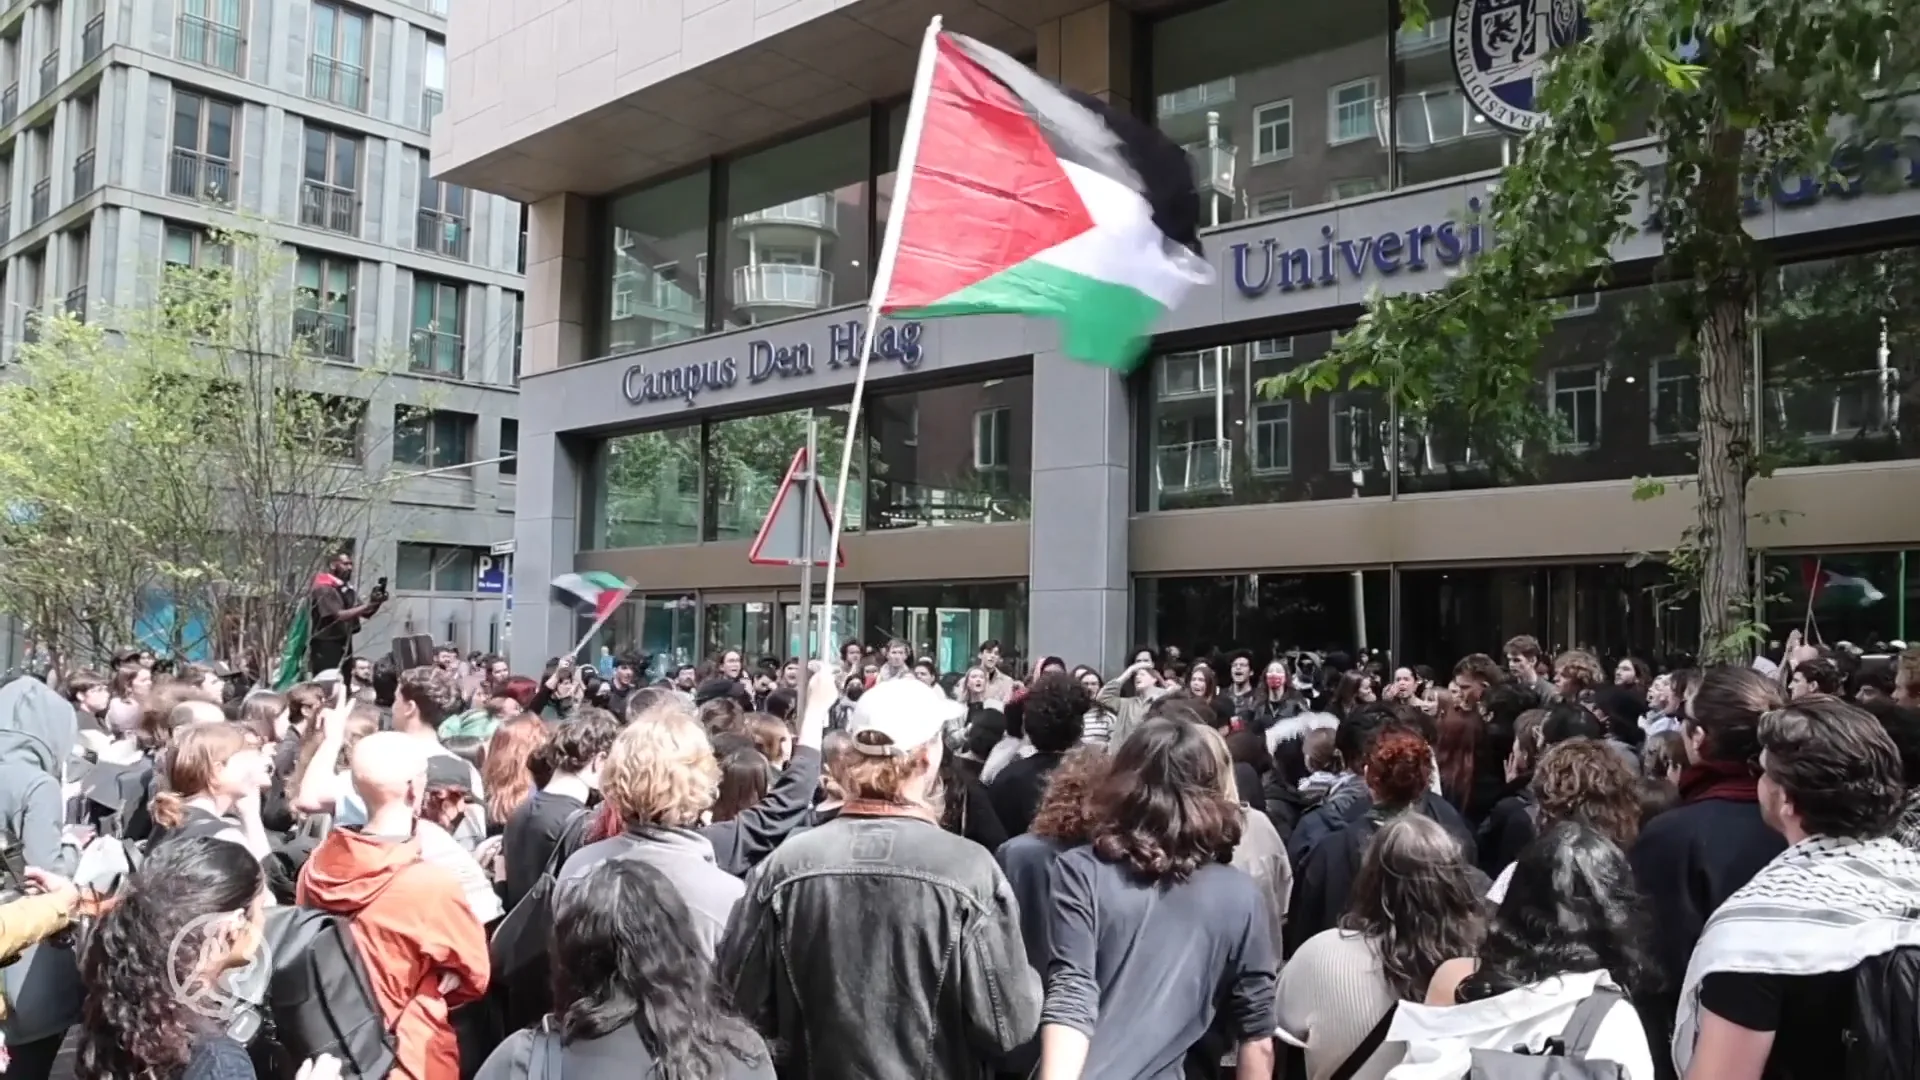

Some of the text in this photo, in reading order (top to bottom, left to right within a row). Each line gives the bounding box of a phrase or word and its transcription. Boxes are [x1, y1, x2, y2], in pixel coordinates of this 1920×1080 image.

[1230, 196, 1485, 299] Universi
[623, 320, 923, 406] Campus Den Haag
[479, 555, 492, 578] P
